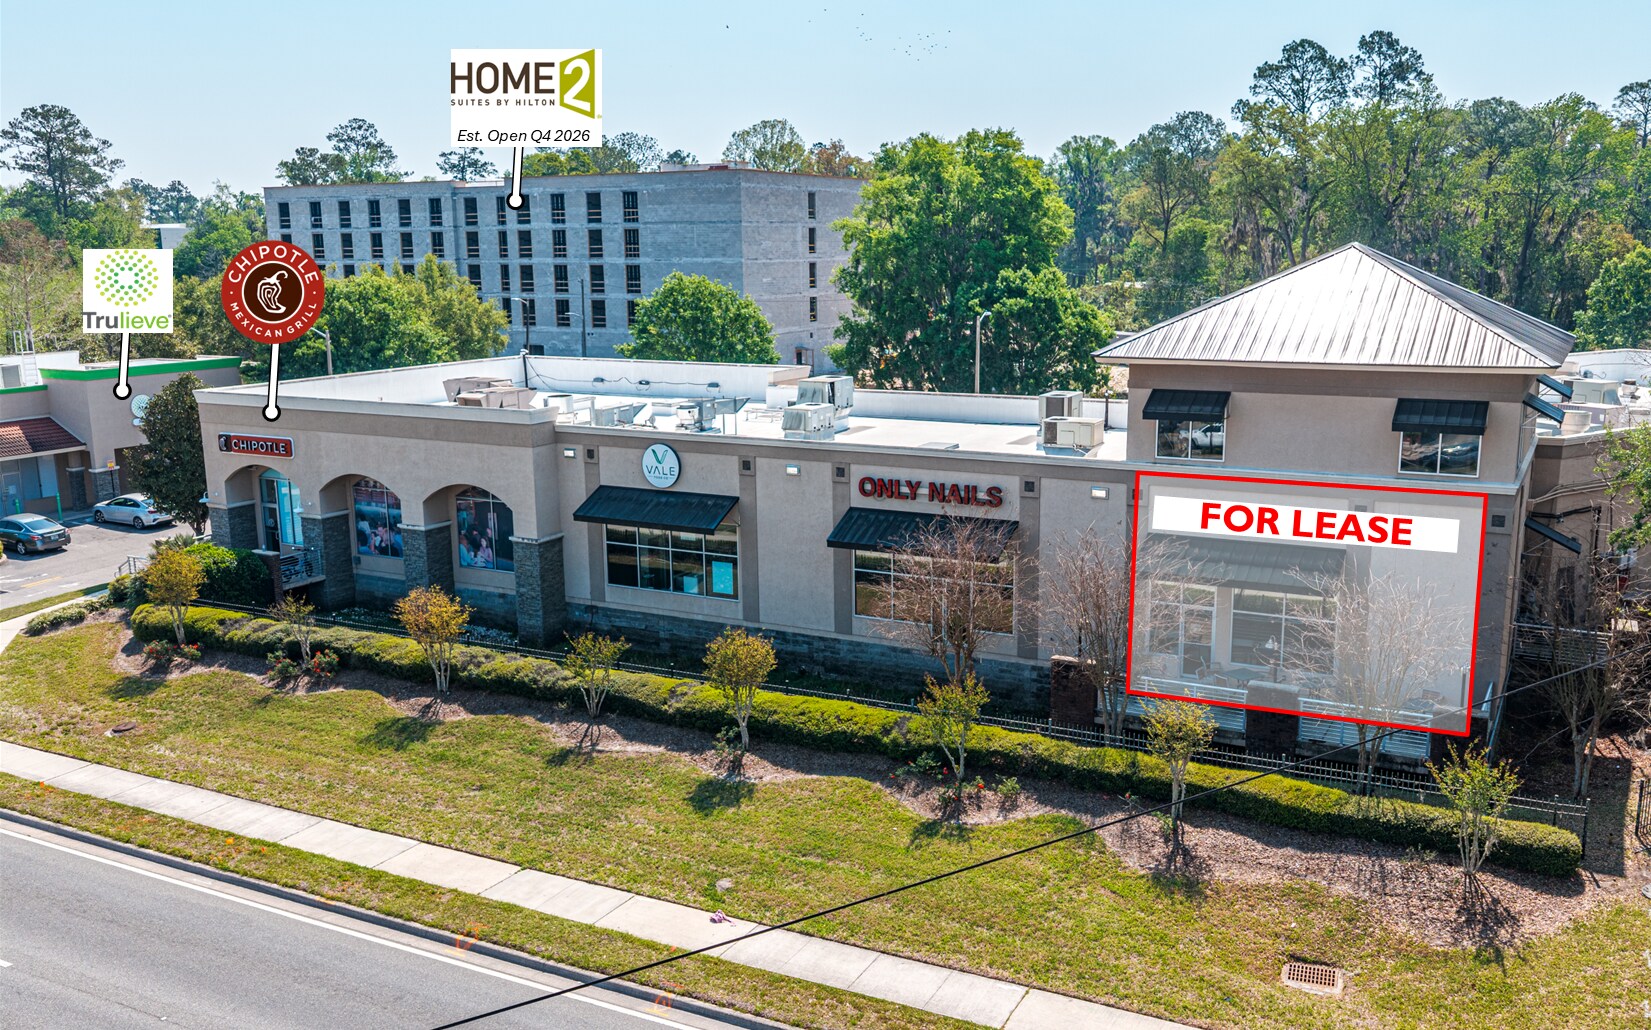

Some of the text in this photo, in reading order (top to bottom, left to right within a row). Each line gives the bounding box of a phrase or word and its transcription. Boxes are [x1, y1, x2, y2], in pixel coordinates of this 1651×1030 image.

[231, 439, 287, 454] CHIPOTLE
[646, 465, 676, 476] VALE
[858, 477, 1003, 508] ONLY NAILS
